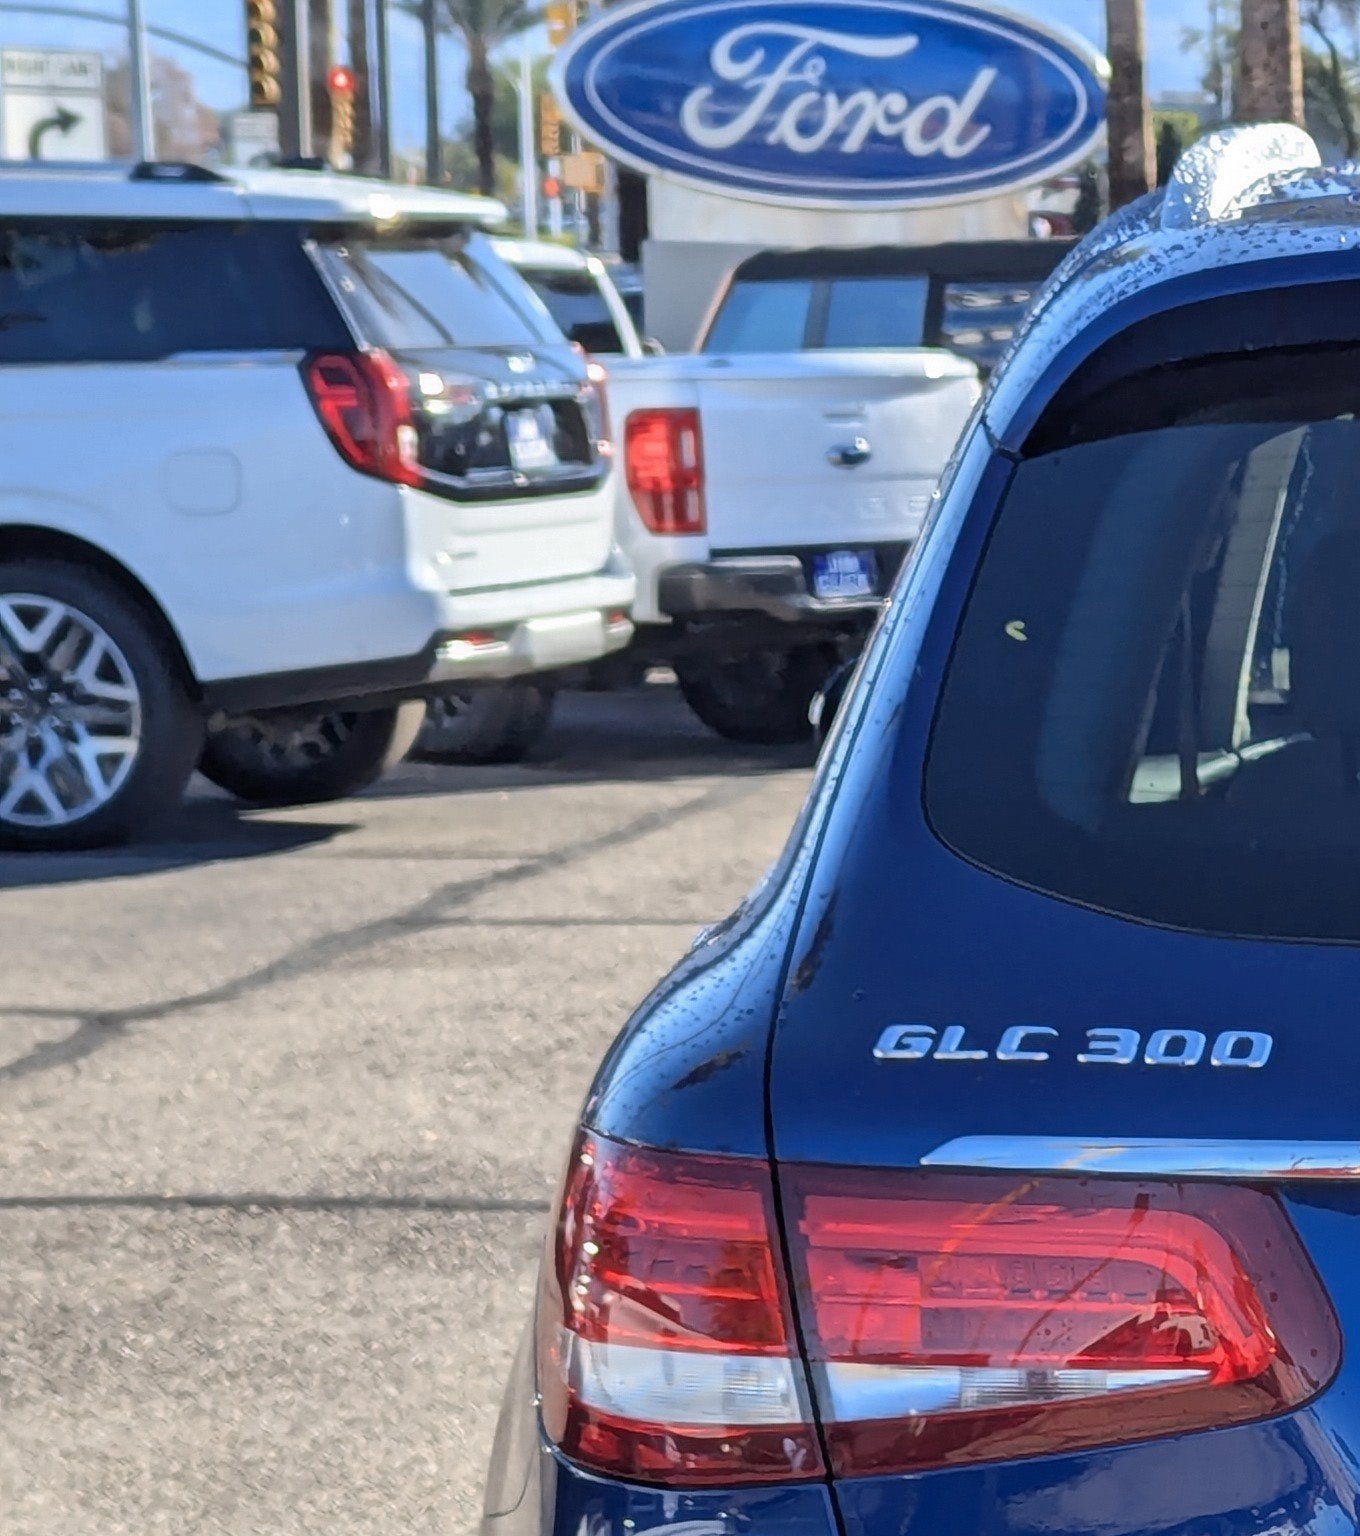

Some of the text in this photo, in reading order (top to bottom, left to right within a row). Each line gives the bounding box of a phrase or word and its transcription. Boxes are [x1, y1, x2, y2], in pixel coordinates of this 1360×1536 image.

[681, 22, 997, 158] Ford
[873, 1024, 1273, 1068] GLC 300
